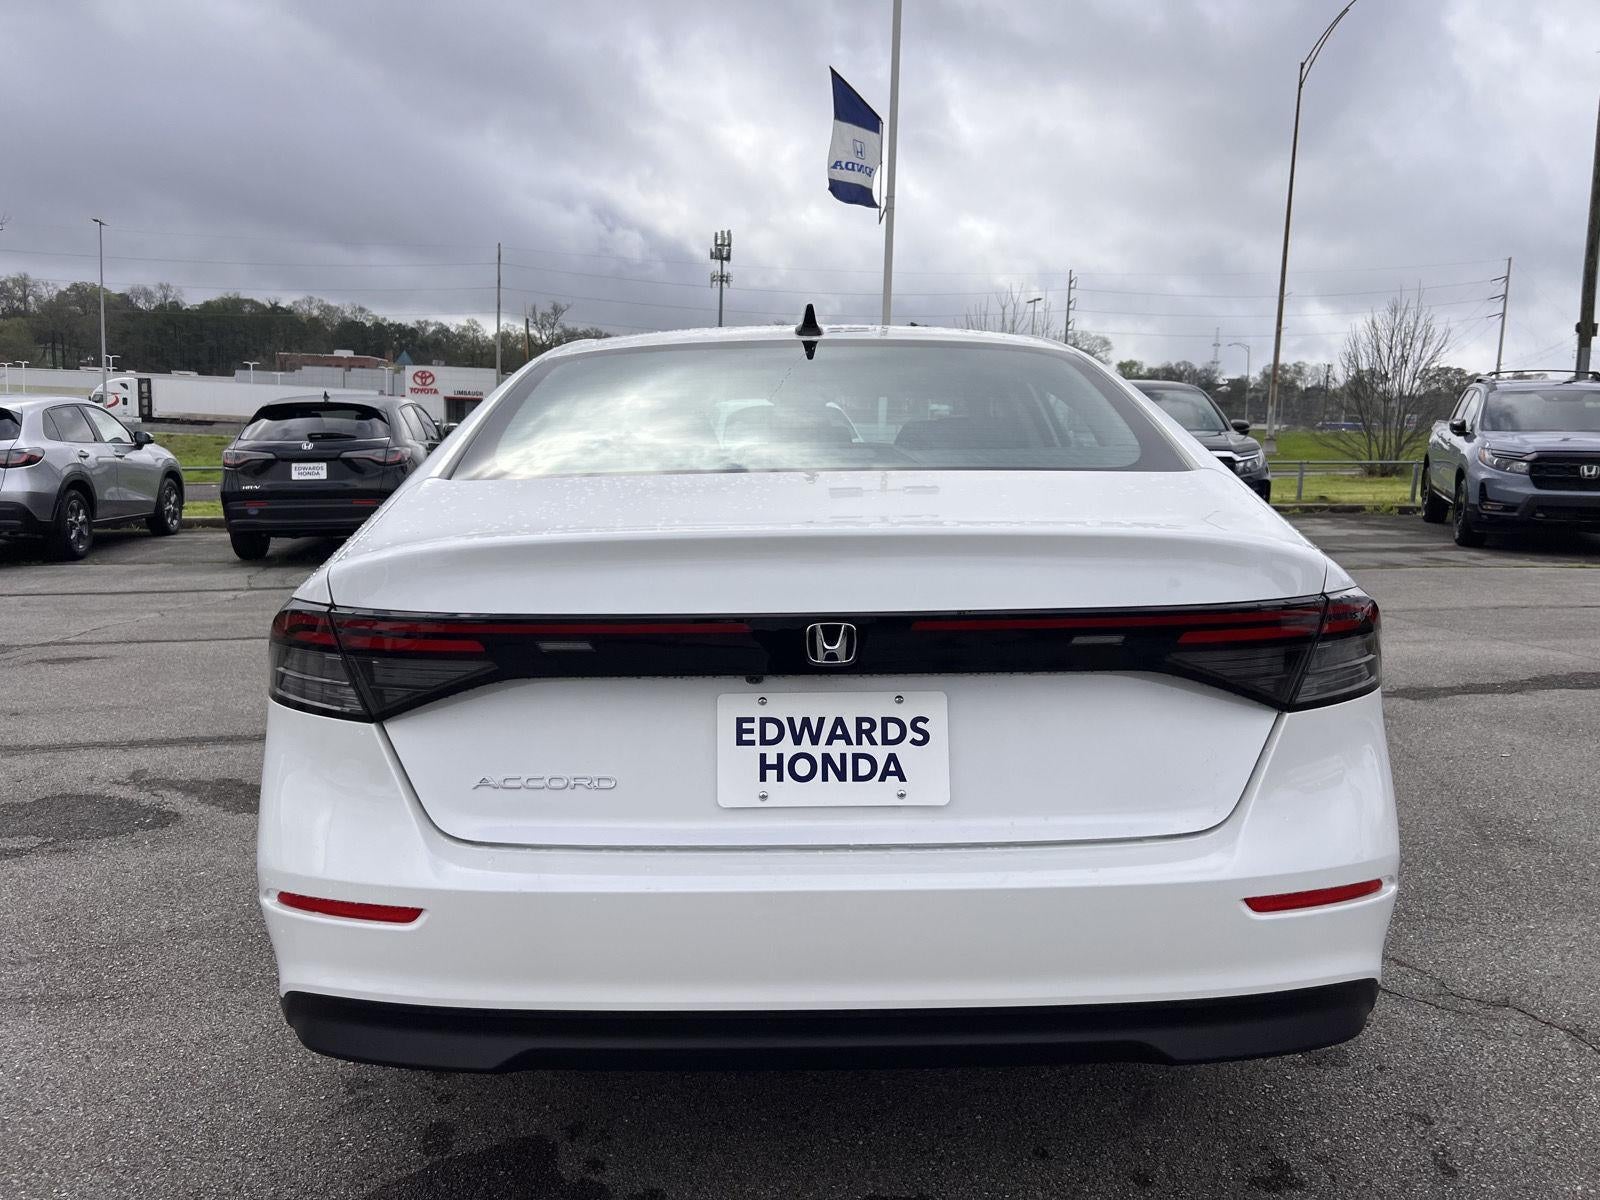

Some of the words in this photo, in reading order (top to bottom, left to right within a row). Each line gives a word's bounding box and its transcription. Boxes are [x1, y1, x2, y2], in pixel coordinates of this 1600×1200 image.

[409, 387, 439, 395] TOYOTA
[735, 715, 931, 747] EDWARDS
[758, 752, 907, 783] HONDA
[472, 775, 618, 791] ACCORD
